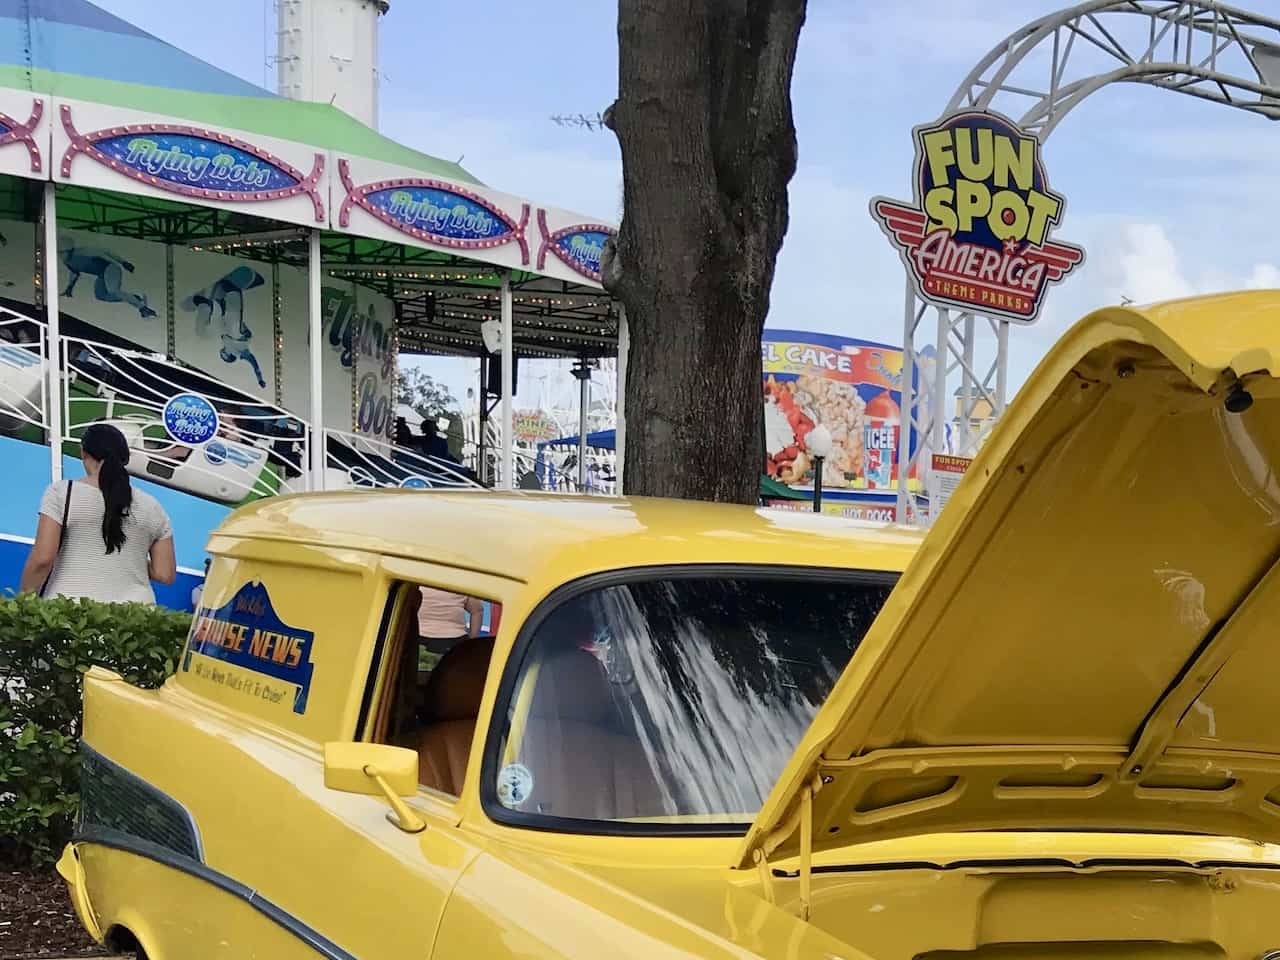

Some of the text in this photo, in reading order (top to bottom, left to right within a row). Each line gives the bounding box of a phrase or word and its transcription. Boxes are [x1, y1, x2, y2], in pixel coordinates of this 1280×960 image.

[126, 138, 271, 187] Flying Bobs
[923, 128, 1034, 190] FUN
[388, 190, 492, 234] Flying Bobs
[925, 179, 1060, 247] SPOT
[913, 230, 1047, 290] AMERICA
[934, 280, 1023, 309] THEME PARKS
[785, 345, 853, 373] CAKE
[169, 401, 210, 421] Flying
[172, 418, 209, 436] Bobs
[866, 426, 895, 449] ICEE
[842, 507, 893, 523] HOT DOGS
[249, 630, 305, 668] NEWS
